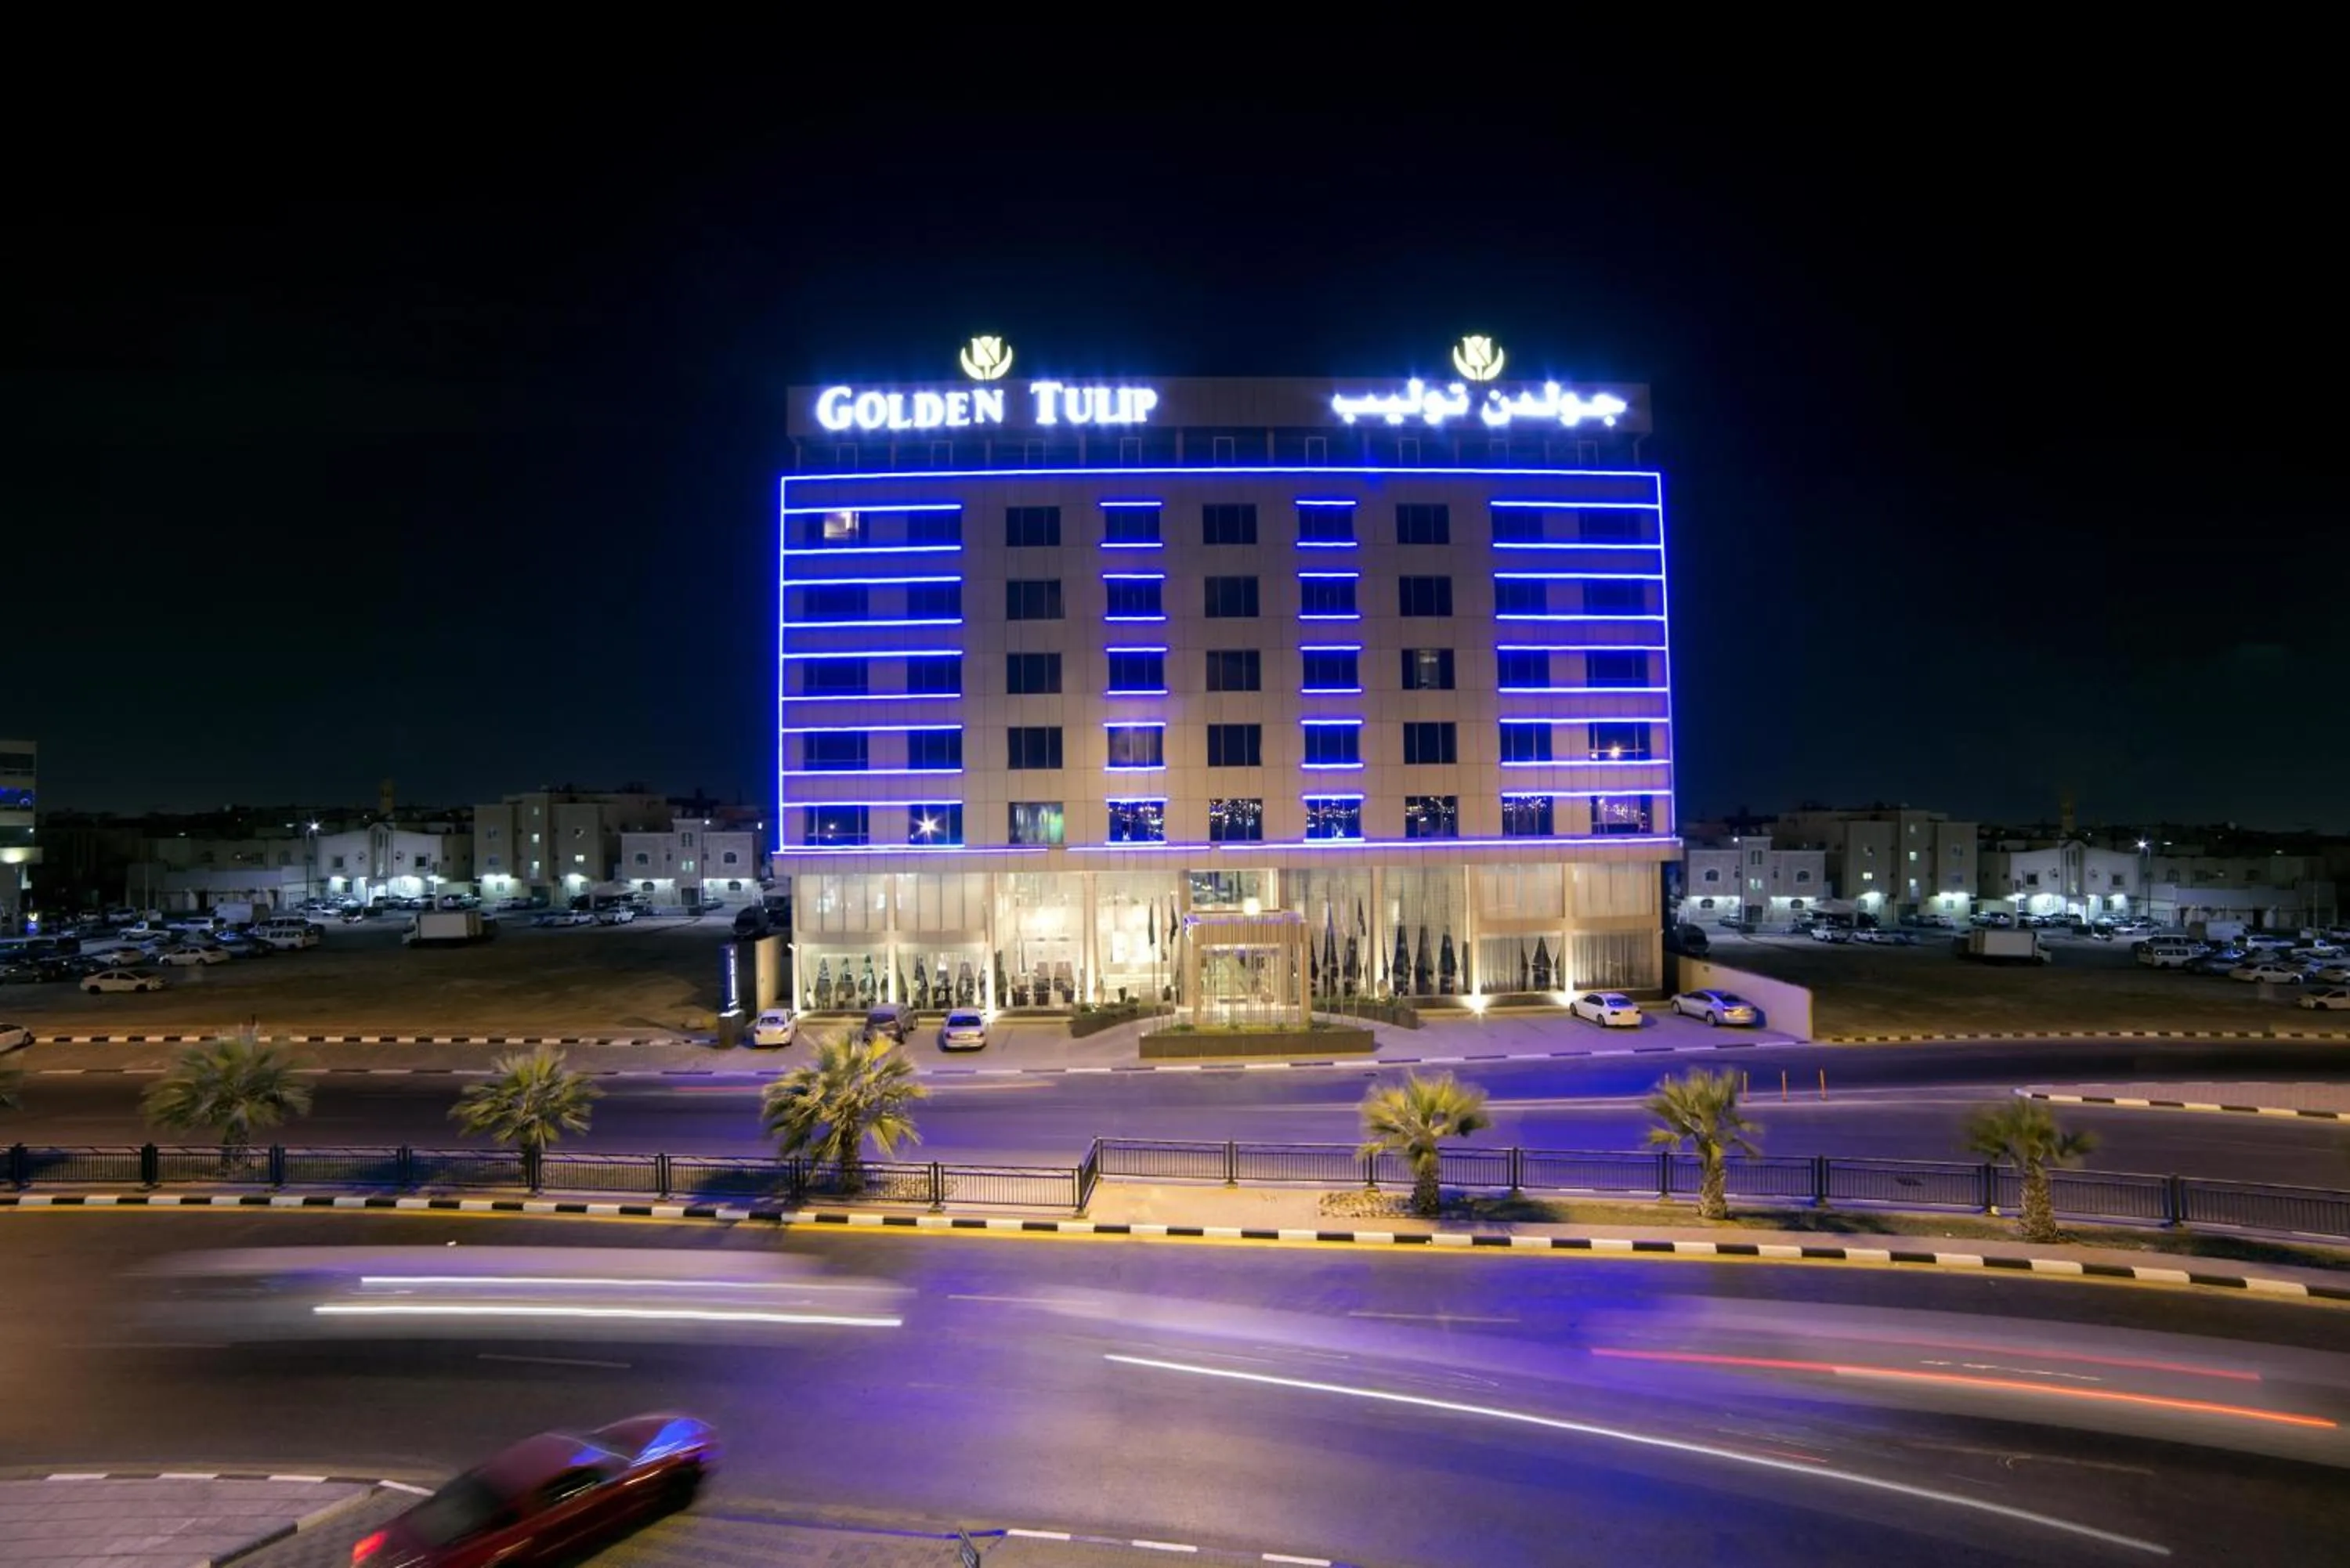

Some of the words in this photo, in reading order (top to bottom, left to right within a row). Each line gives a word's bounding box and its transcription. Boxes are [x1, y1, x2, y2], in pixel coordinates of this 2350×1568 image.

[817, 386, 1004, 430] GOLDEN
[1030, 381, 1158, 425] TULIP
[1332, 378, 1470, 425] توليب
